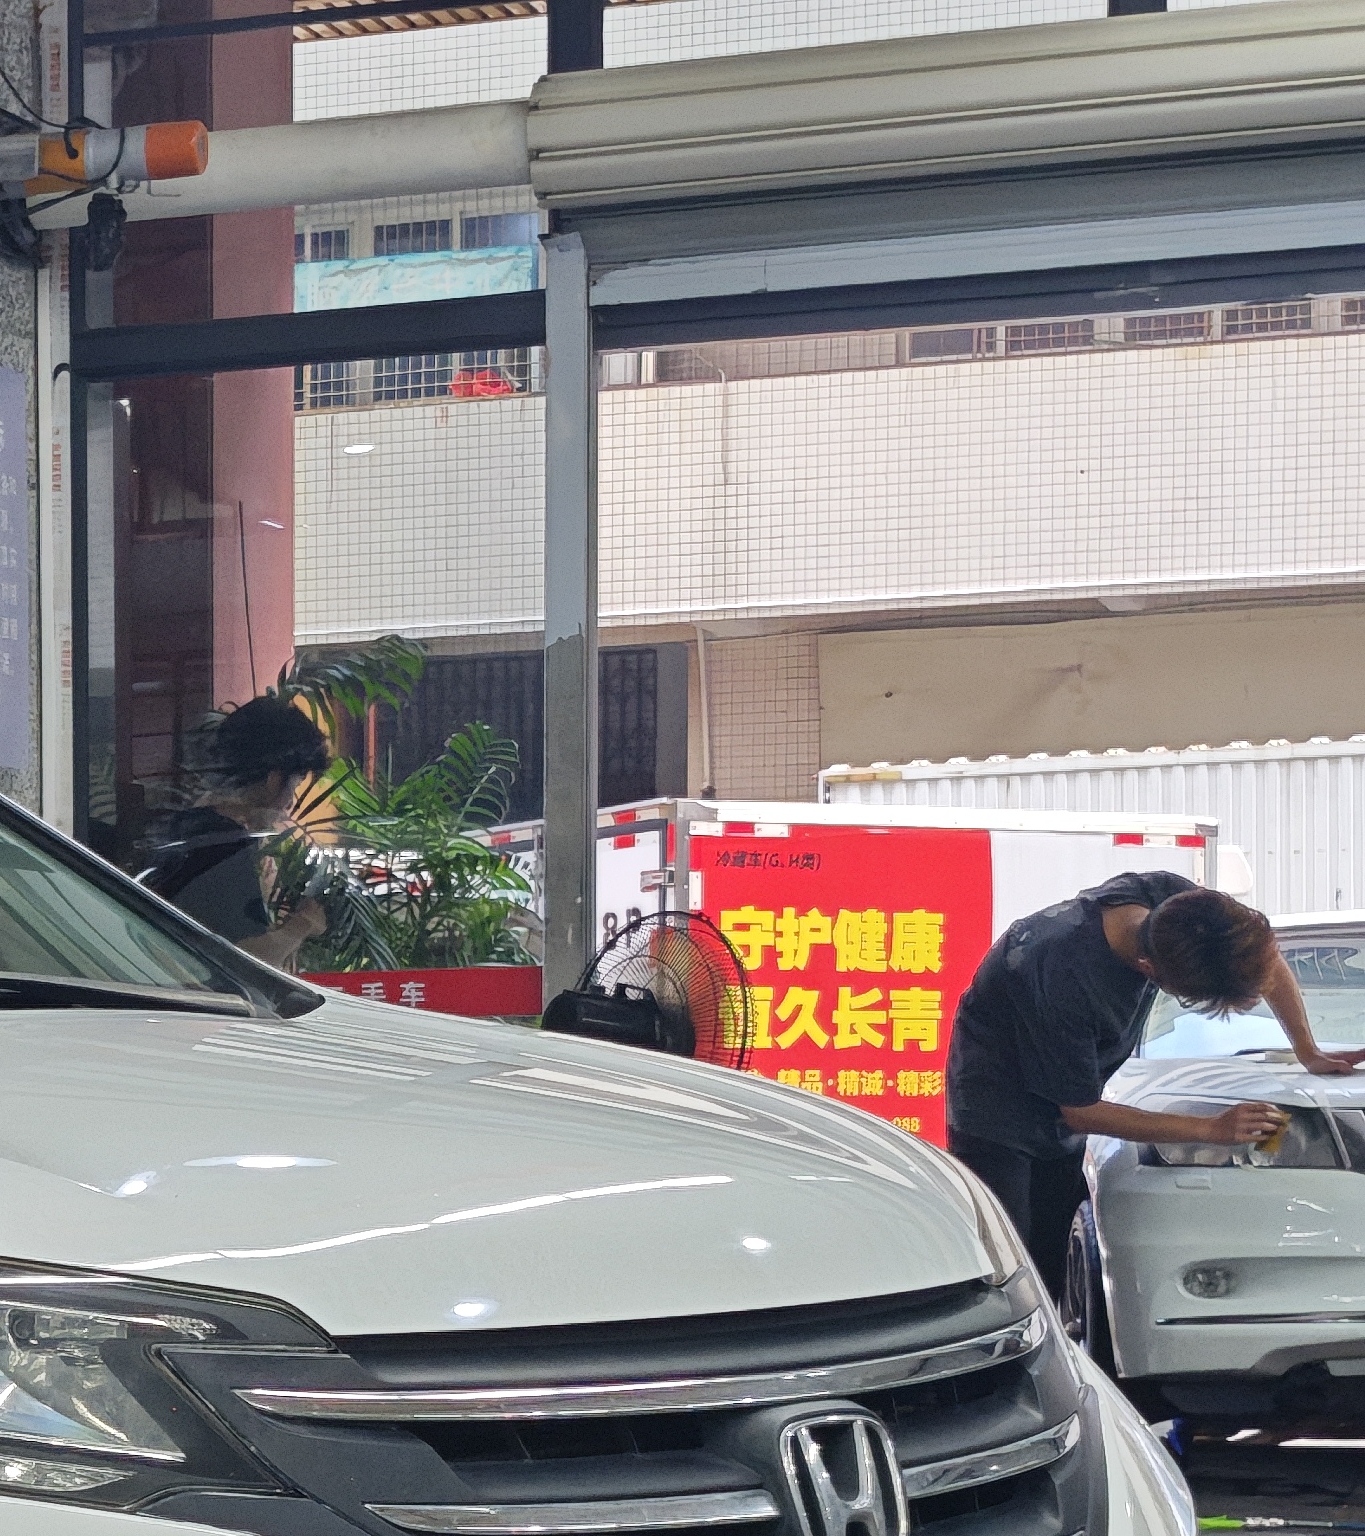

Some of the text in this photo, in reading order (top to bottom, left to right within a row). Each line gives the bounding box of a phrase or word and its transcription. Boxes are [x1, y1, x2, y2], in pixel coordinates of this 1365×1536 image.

[720, 905, 944, 974] 守护健康
[326, 981, 426, 1008] 手车
